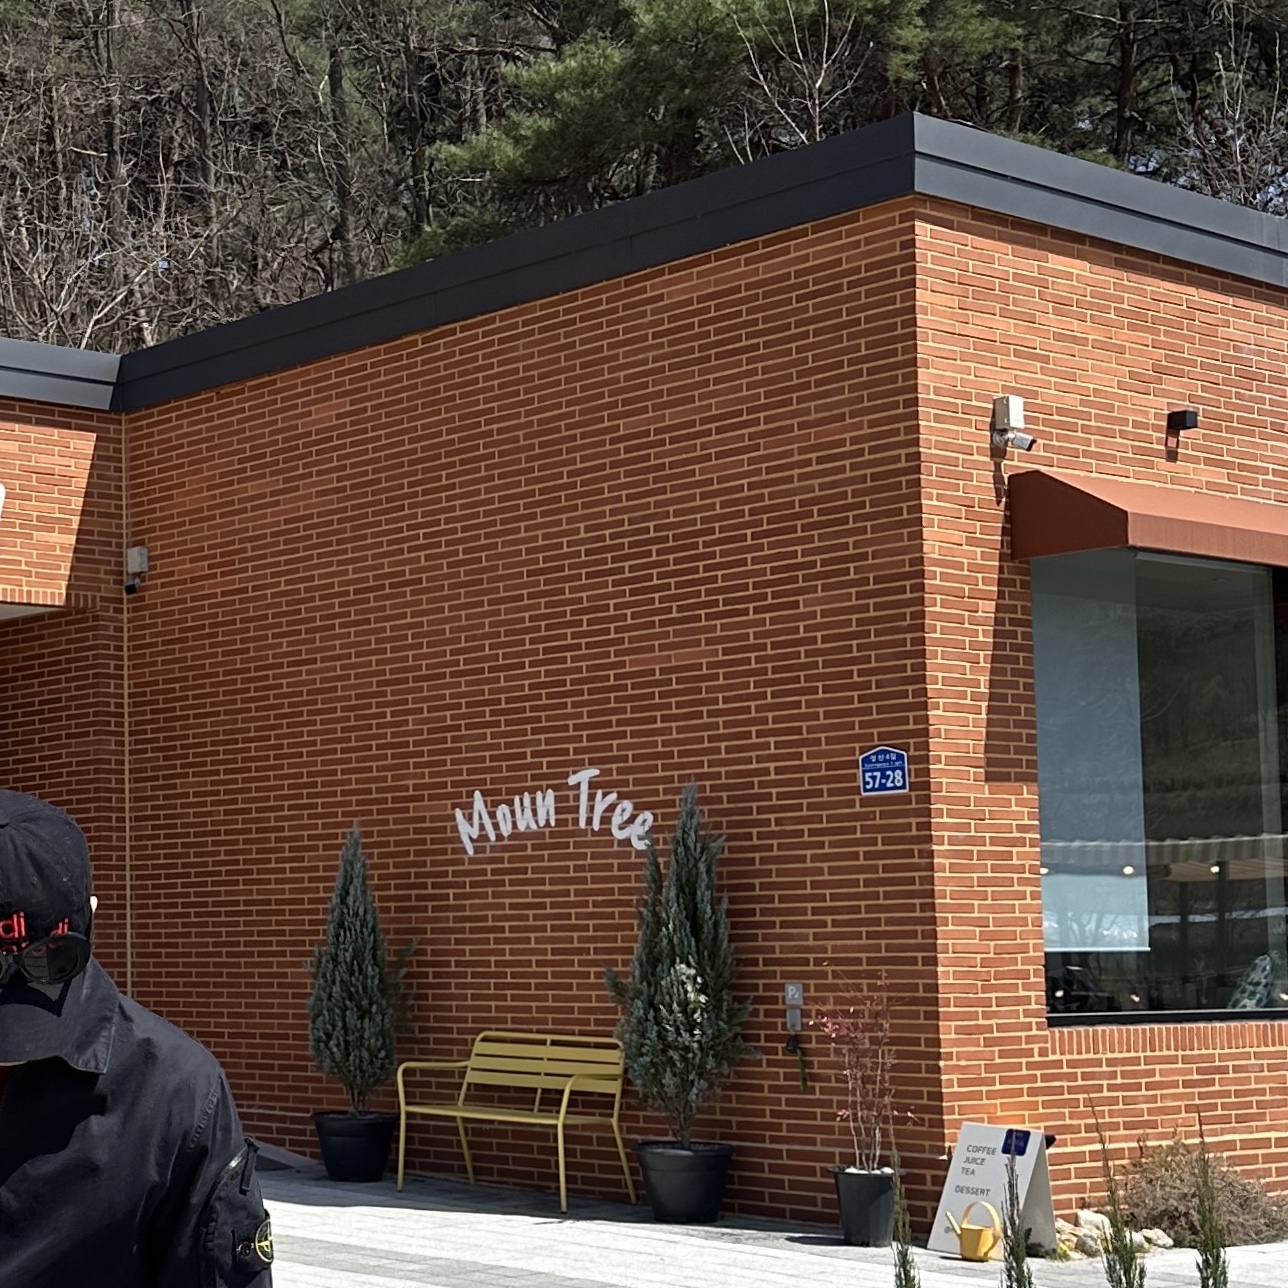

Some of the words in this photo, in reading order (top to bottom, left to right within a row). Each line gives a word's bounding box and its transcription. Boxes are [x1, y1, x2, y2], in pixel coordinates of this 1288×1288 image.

[864, 770, 903, 789] 57-28
[455, 788, 556, 856] Moun
[567, 768, 654, 850] Tree
[788, 986, 797, 999] P
[966, 1145, 997, 1156] COFFEE
[962, 1156, 987, 1166] JUICE
[961, 1167, 976, 1176] TEA
[954, 1184, 991, 1197] DESSERT
